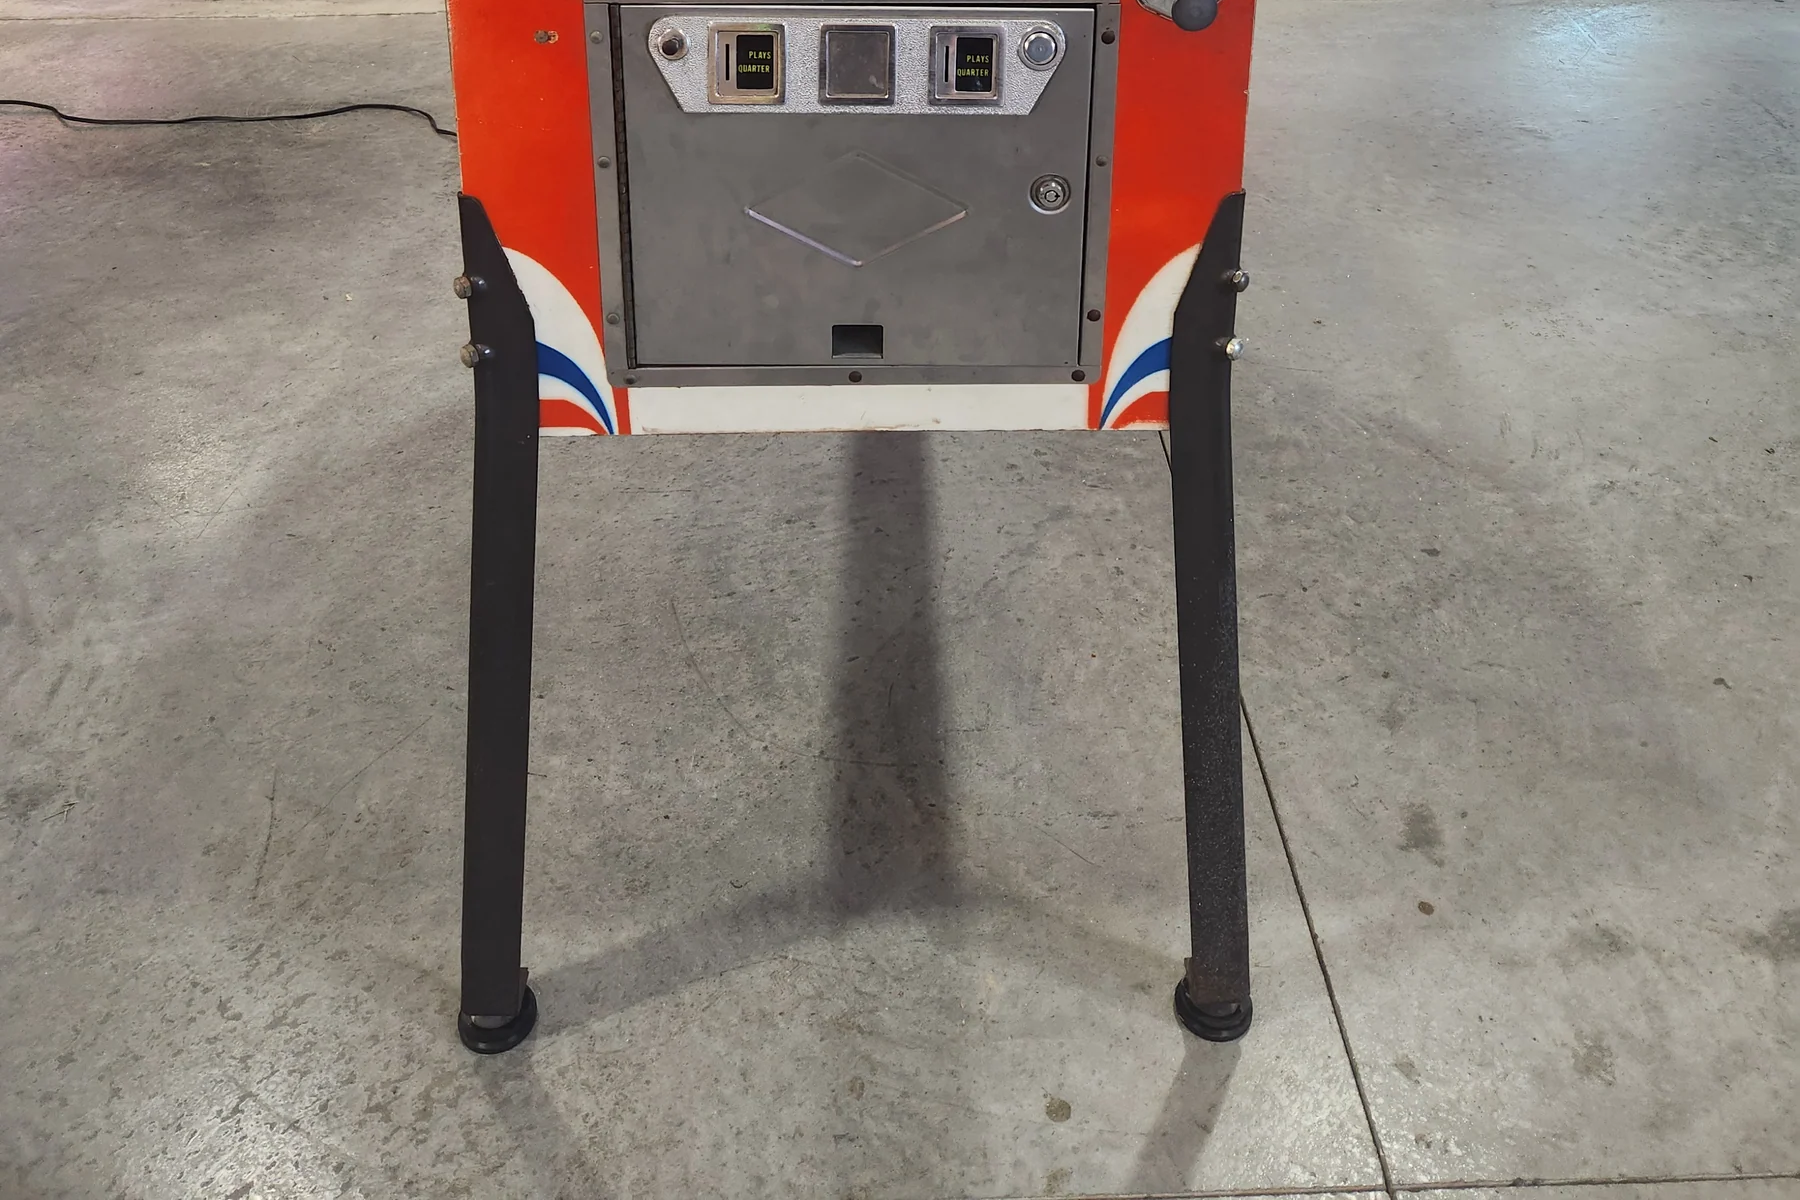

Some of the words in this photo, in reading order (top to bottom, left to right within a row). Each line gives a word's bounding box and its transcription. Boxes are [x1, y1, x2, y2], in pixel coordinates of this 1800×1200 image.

[748, 50, 772, 60] PLAYS
[966, 54, 990, 63] PLAYS
[738, 64, 770, 73] QUARTER
[957, 68, 989, 77] QUARTER
